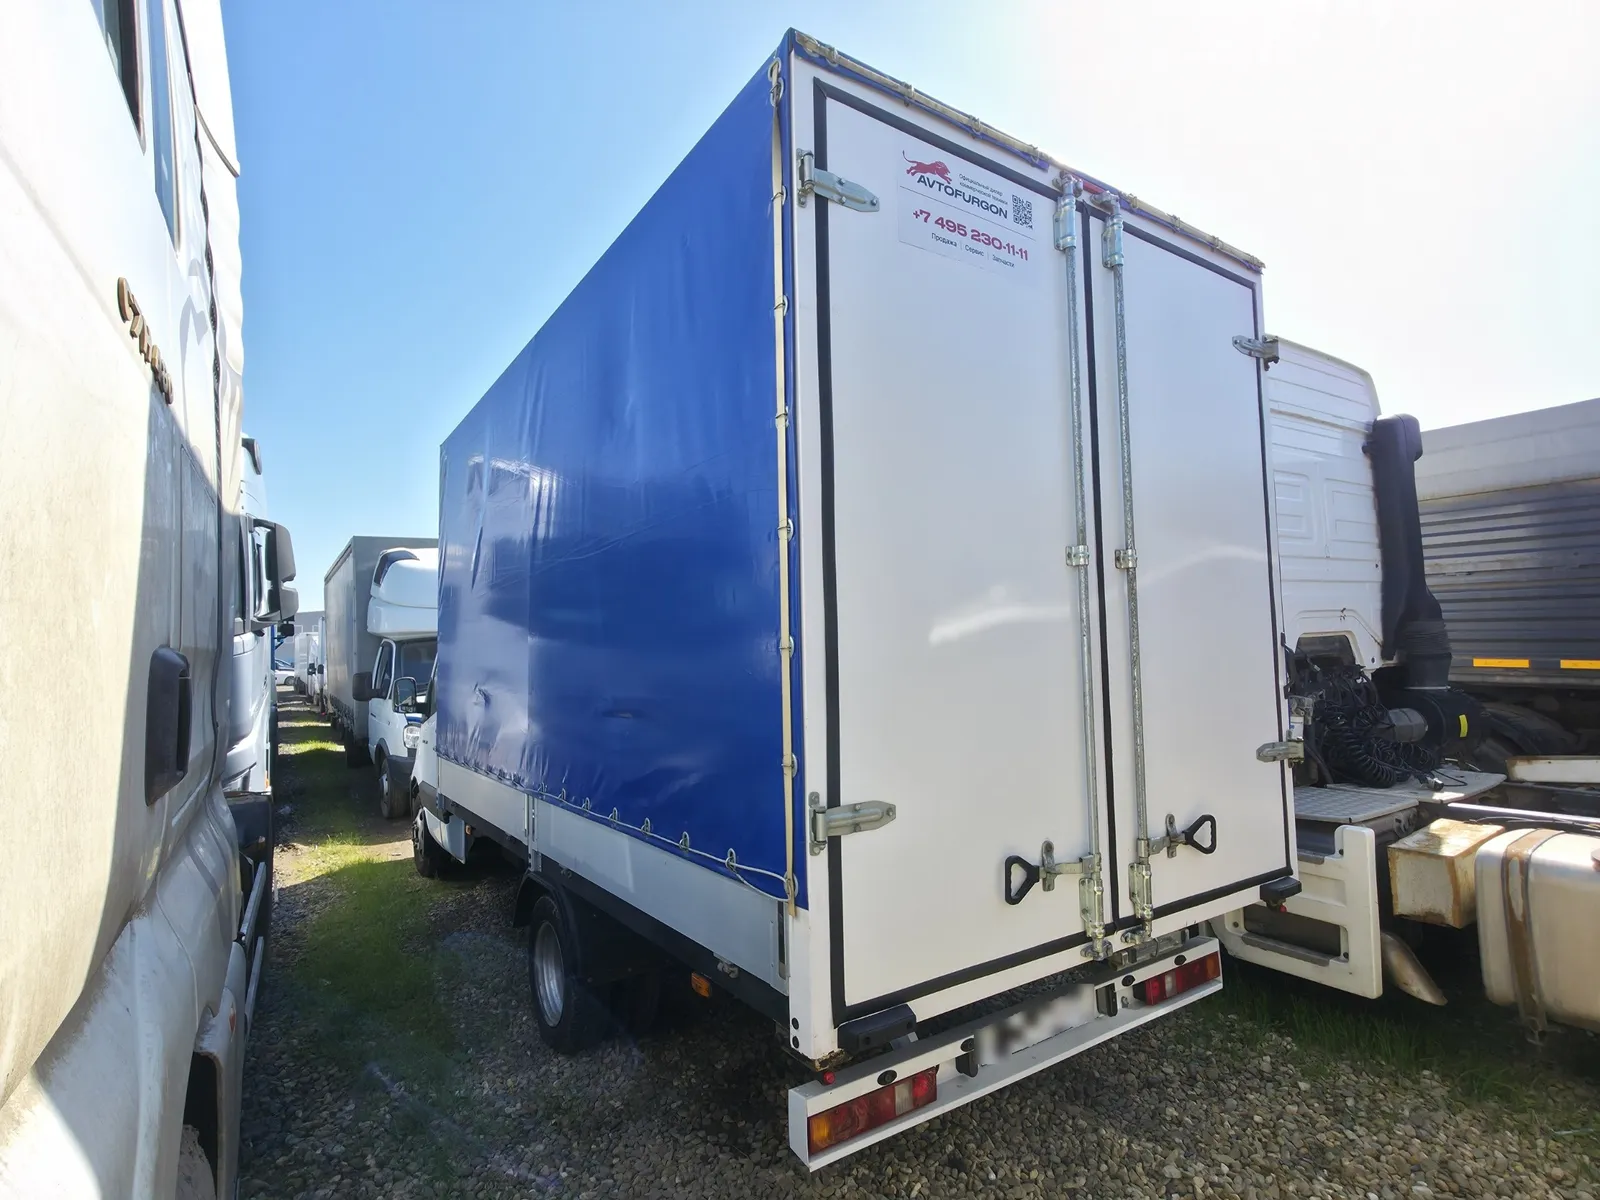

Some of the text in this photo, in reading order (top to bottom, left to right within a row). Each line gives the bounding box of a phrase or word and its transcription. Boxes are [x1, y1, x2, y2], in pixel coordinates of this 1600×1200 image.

[917, 175, 1008, 219] AVTOFURGON
[913, 209, 1028, 261] +7 495 230-11-11
[931, 232, 1015, 268] Продажа Сервис Запчасти
